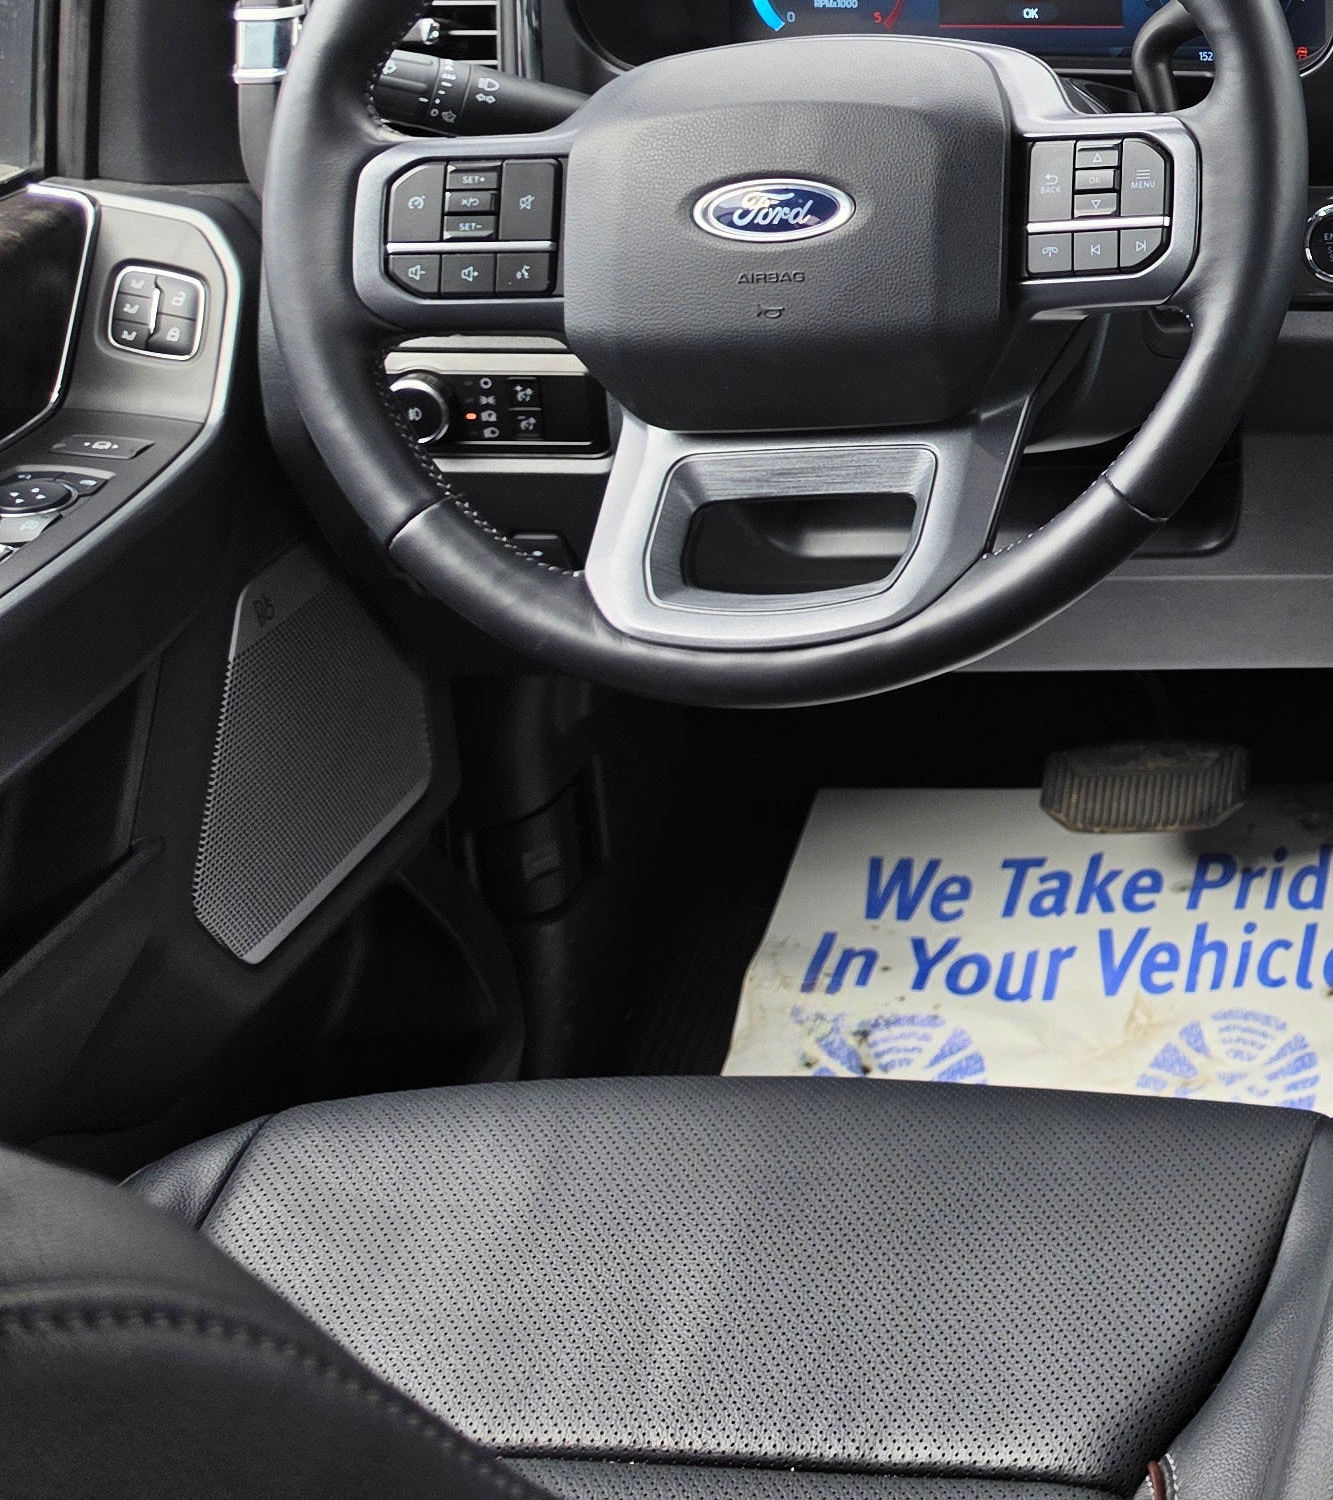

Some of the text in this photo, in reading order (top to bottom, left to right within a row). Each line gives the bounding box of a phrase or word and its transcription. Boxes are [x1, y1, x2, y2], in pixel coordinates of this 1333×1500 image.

[786, 11, 796, 23] 0
[872, 11, 882, 24] 5
[1022, 7, 1039, 19] OK
[1040, 184, 1062, 196] BACK
[1130, 179, 1157, 191] MENU
[732, 191, 813, 228] Ford
[737, 270, 806, 285] AIRBAG
[863, 854, 973, 923] We
[1000, 852, 1163, 920] Take
[800, 931, 880, 995] In
[908, 934, 1077, 1003] Your
